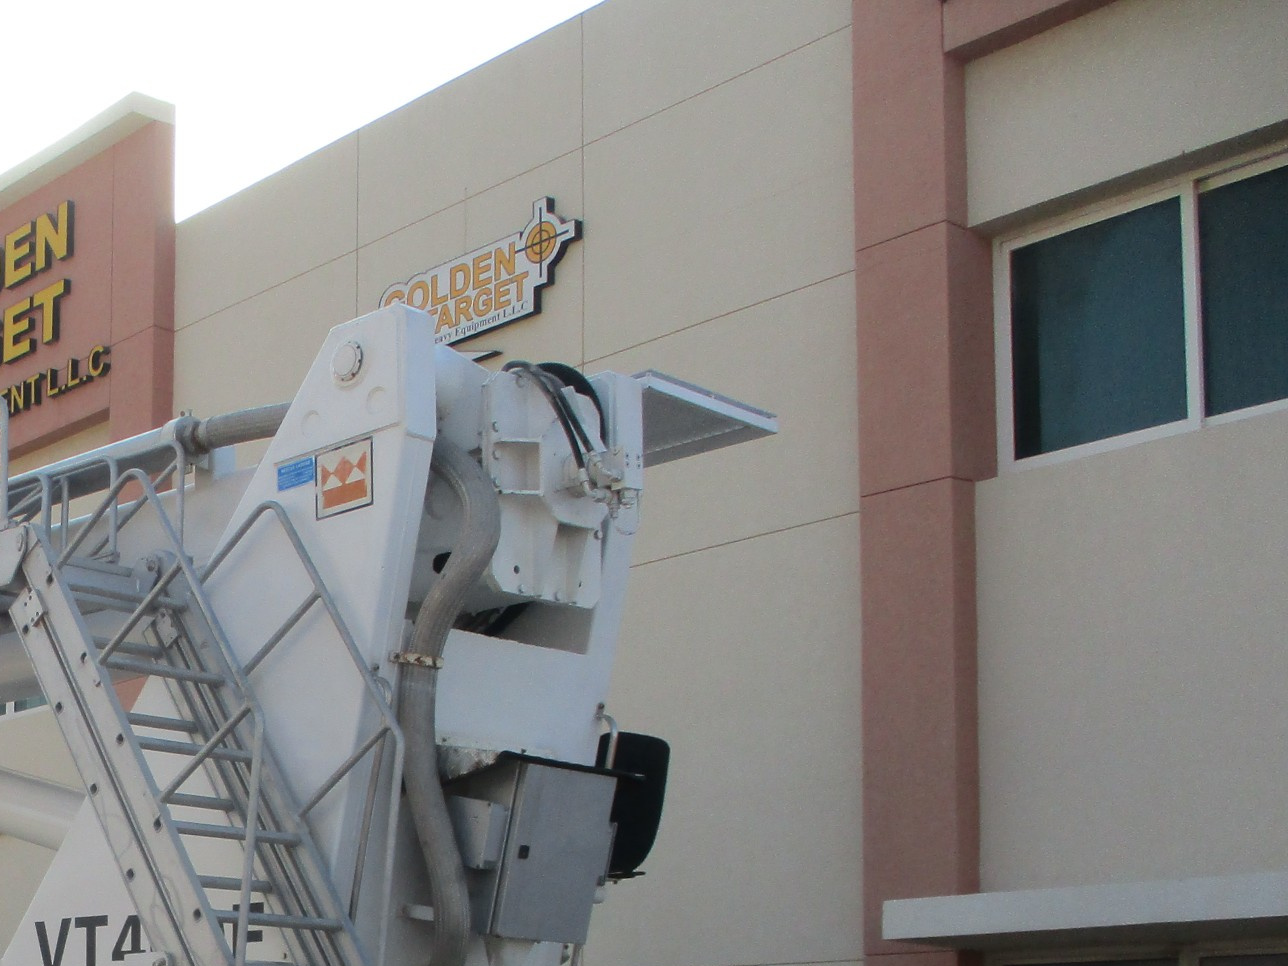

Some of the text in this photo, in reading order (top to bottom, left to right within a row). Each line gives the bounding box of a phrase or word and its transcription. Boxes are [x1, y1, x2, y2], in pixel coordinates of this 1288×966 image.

[434, 331, 453, 345] eavy
[455, 311, 501, 338] Equipment
[46, 345, 111, 398] L.L.C
